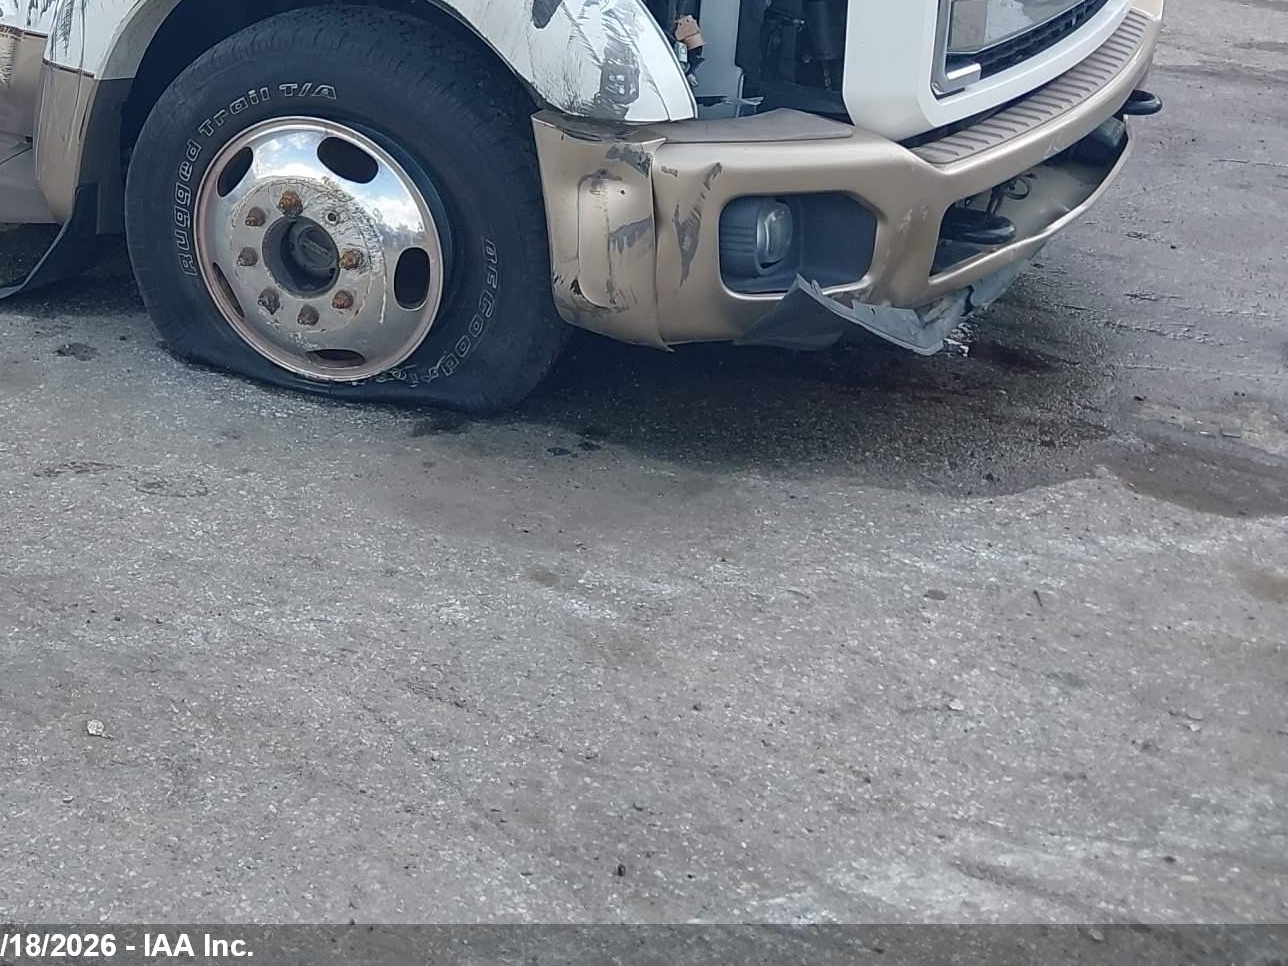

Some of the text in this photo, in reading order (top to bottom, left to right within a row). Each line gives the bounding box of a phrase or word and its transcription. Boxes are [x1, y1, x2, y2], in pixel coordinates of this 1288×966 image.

[175, 83, 337, 276] Rugged Trail T/A
